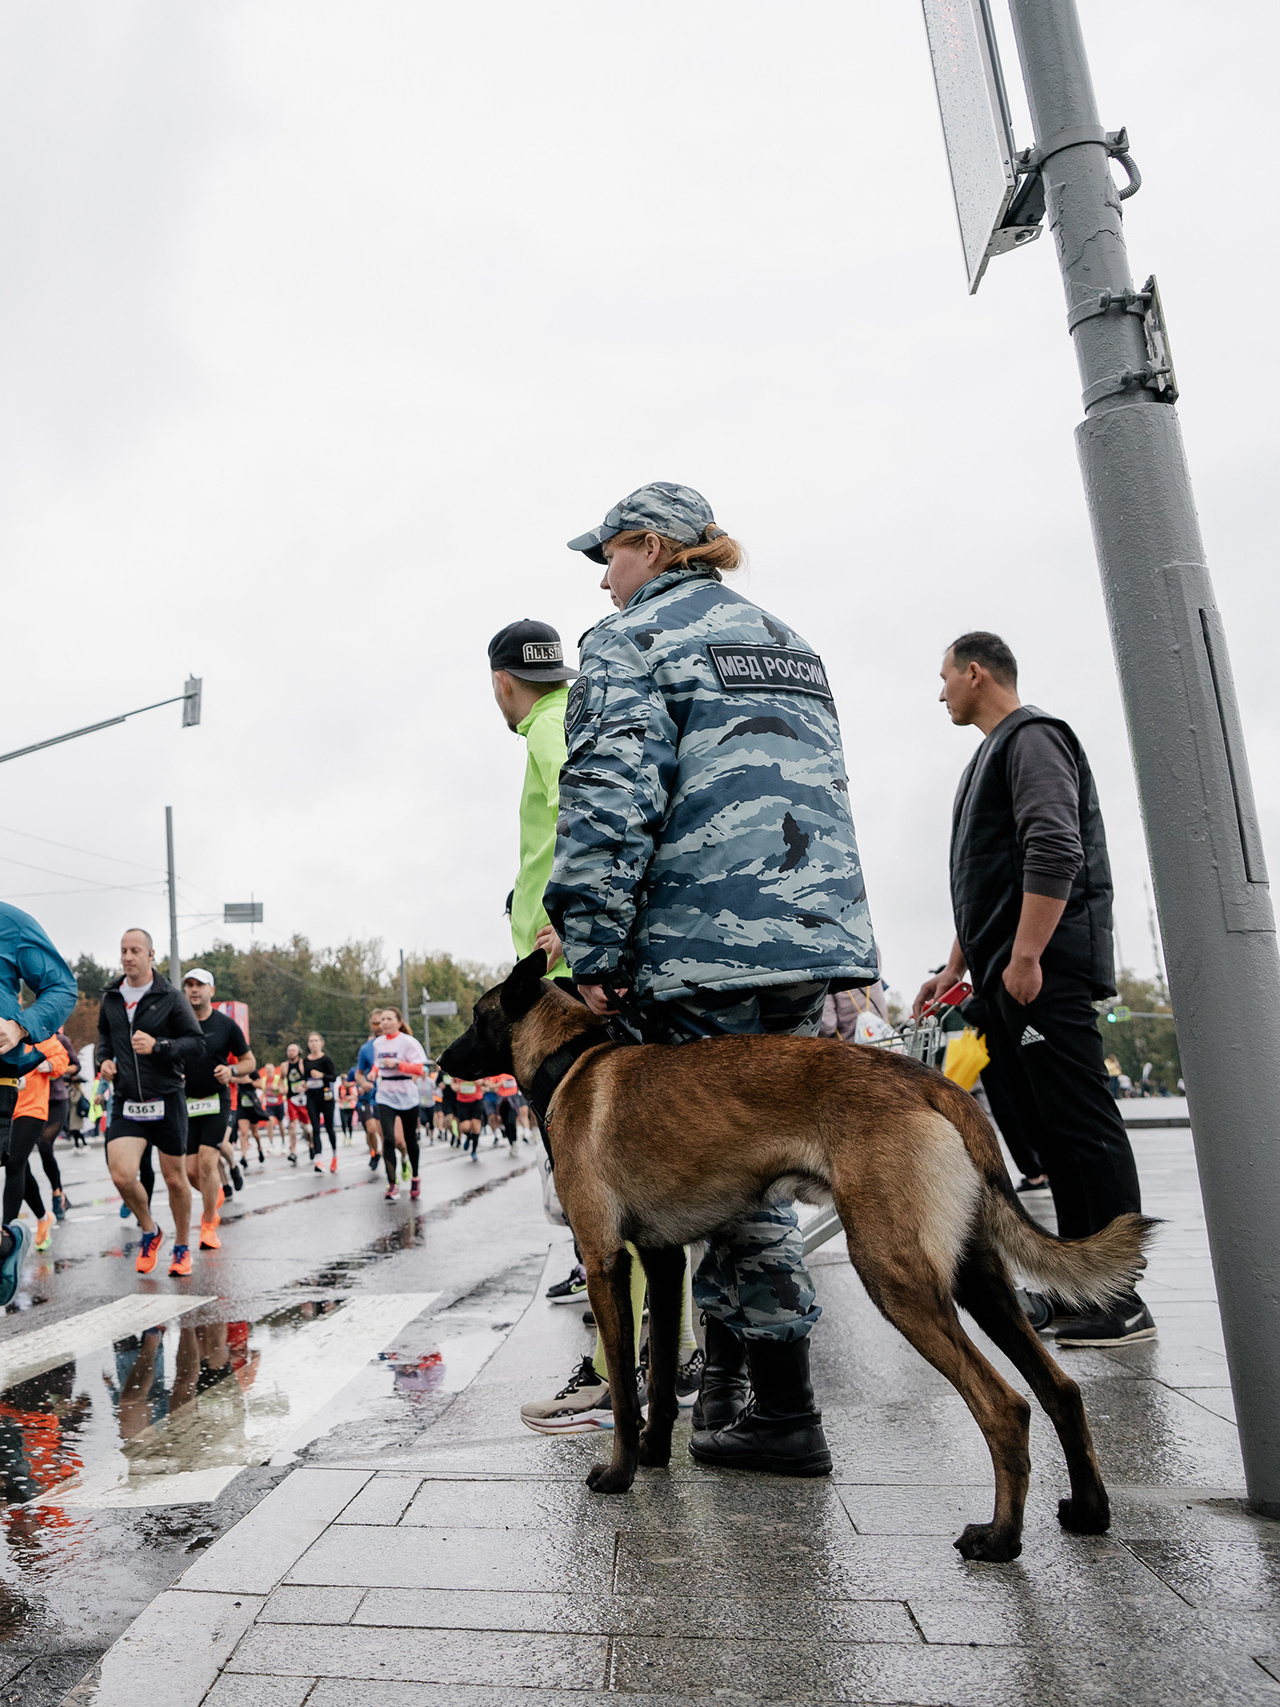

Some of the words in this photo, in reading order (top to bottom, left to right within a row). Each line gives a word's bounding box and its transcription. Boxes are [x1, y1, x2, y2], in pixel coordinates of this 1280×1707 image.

[717, 655, 766, 680] МВД
[762, 656, 827, 687] РОССИИ
[128, 1105, 155, 1114] 6363
